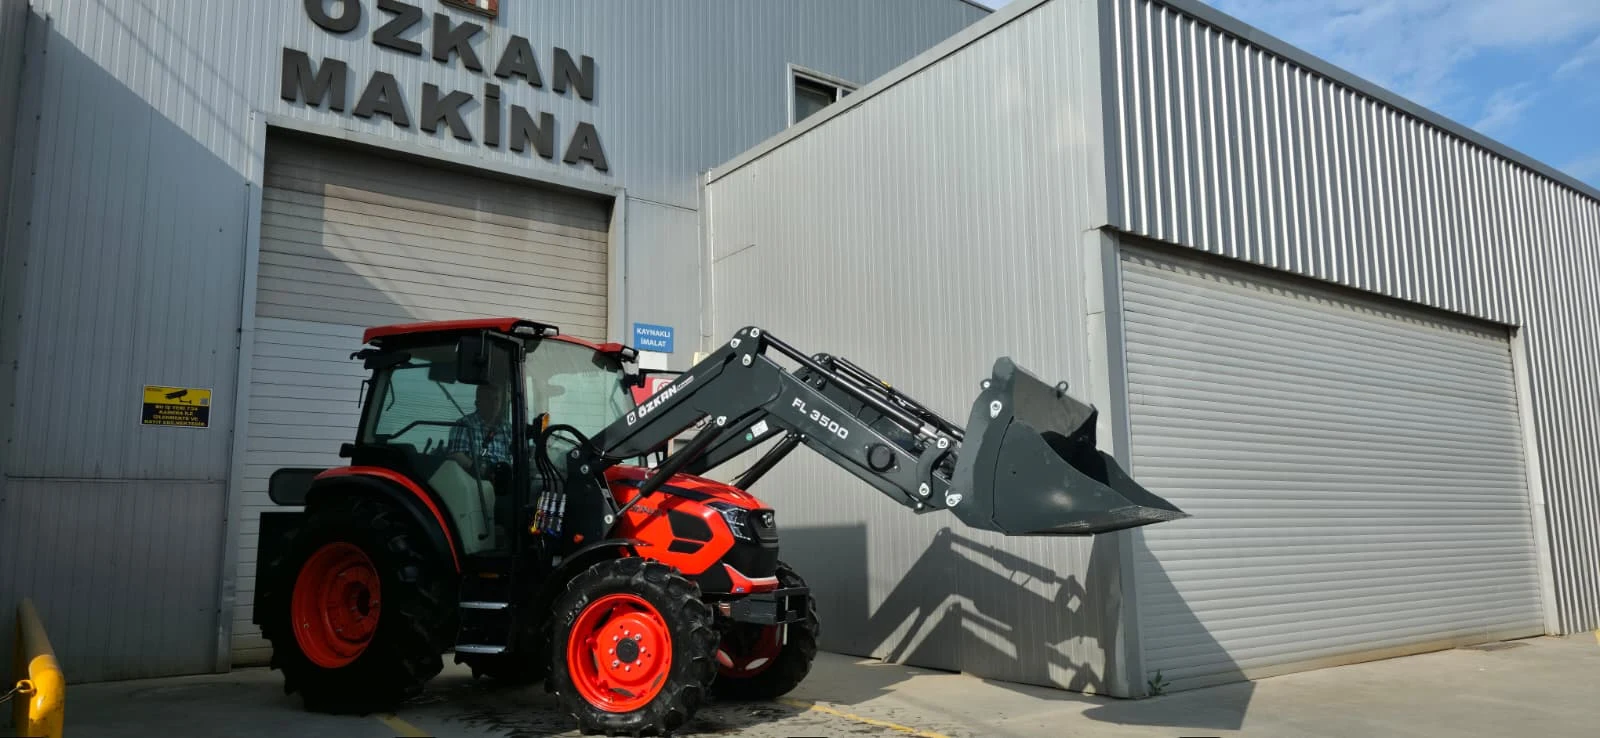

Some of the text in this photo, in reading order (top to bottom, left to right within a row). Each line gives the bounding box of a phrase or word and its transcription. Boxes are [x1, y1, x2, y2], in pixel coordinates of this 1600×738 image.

[281, 47, 608, 172] MAKİNA
[636, 327, 671, 338] KAYNAKLI
[638, 384, 678, 418] ÖZKAN
[791, 397, 849, 440] FL 3500
